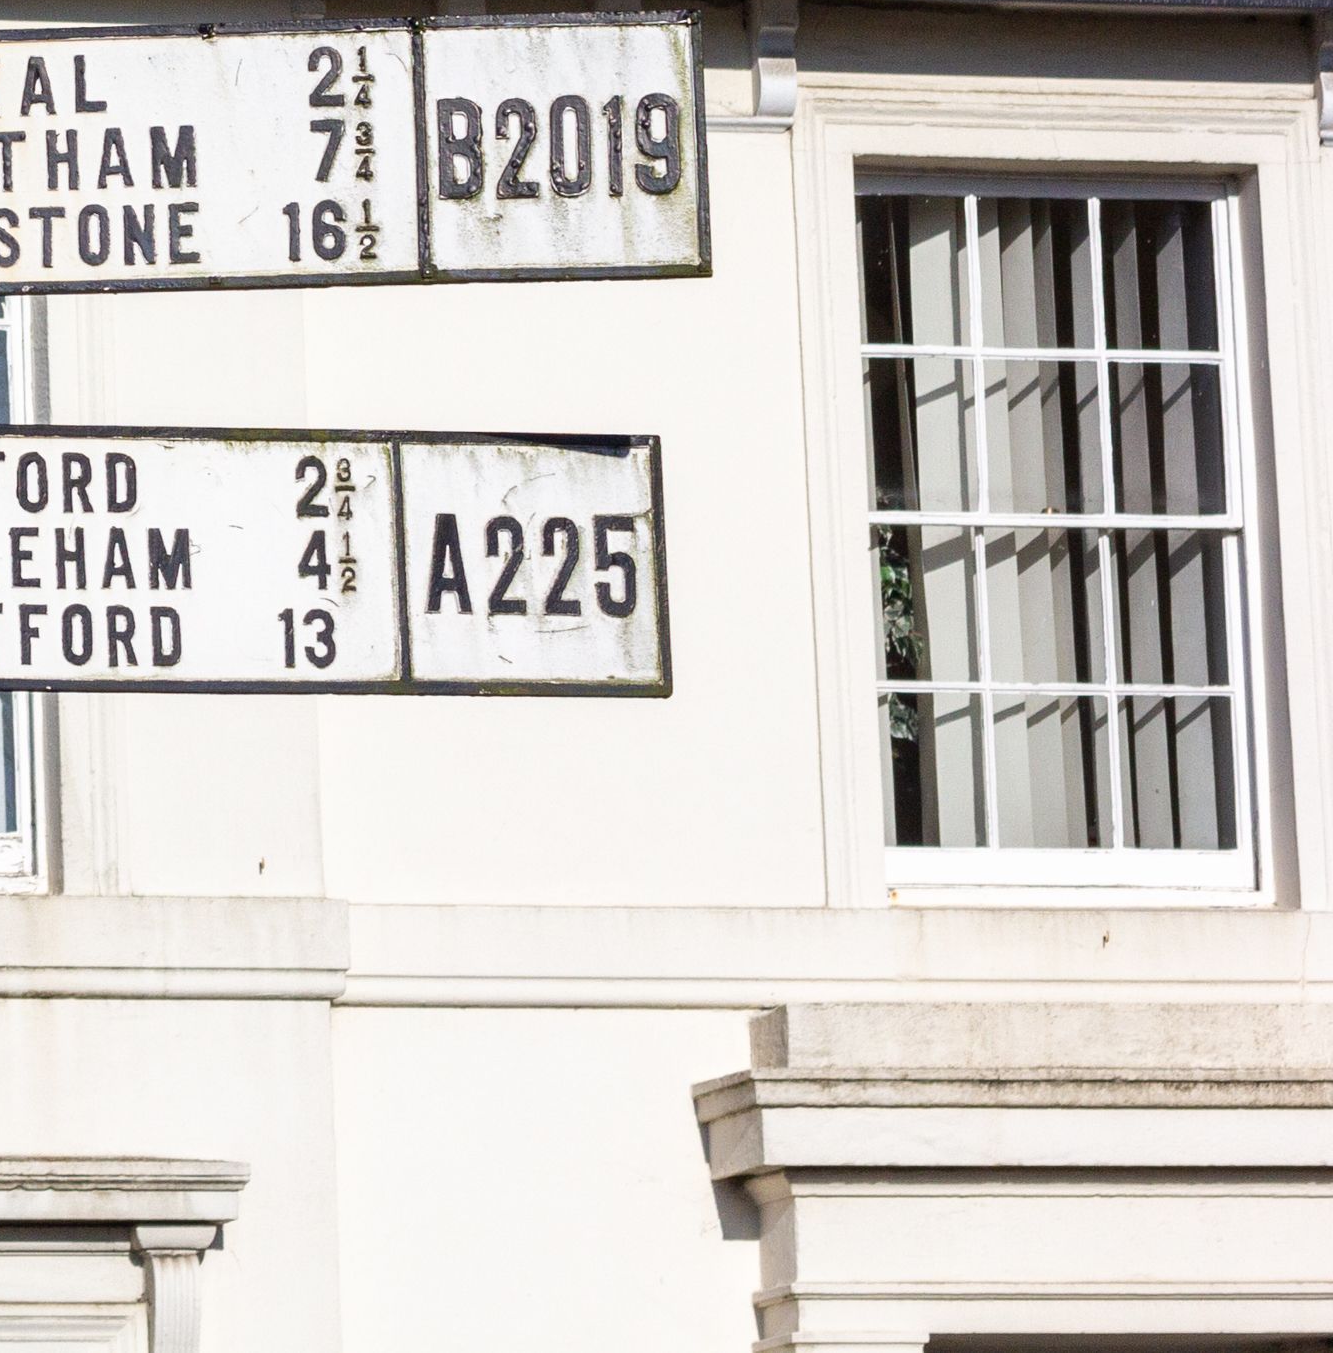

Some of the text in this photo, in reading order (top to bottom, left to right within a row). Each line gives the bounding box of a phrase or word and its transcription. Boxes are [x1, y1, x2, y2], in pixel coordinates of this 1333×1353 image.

[436, 93, 683, 202] B2019
[427, 513, 638, 619] A225
[278, 608, 336, 669] 13
